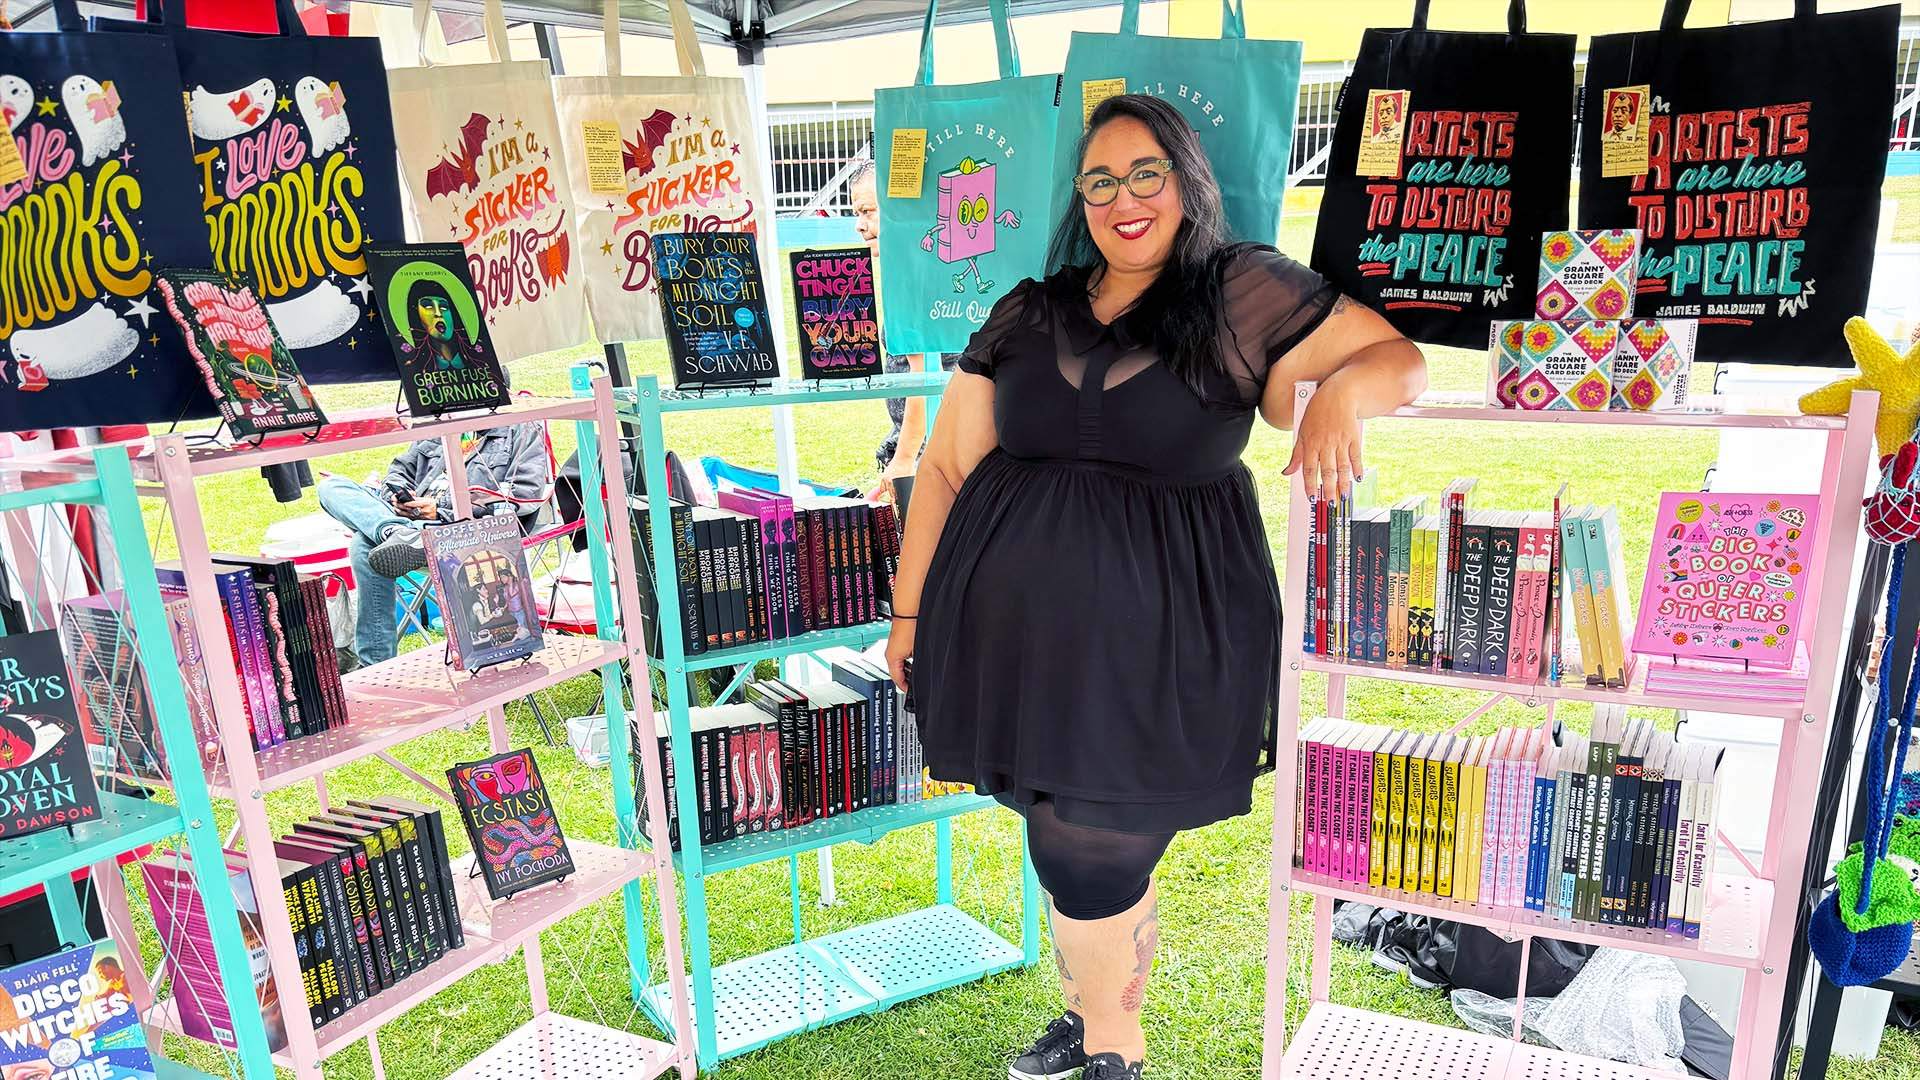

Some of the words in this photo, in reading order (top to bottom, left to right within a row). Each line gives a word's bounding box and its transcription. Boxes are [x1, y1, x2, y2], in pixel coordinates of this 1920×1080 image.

[1178, 84, 1224, 127] HERE
[976, 123, 1014, 158] HERE
[1398, 111, 1520, 165] RTISTS
[194, 147, 224, 212] I
[1407, 159, 1456, 184] are
[1454, 154, 1511, 186] here
[1676, 164, 1730, 192] are
[1732, 154, 1806, 189] here
[458, 166, 556, 248] SUCKER
[614, 160, 742, 234] SUCKER
[1366, 184, 1398, 230] TO
[1401, 186, 1512, 235] DISTURB
[650, 214, 681, 232] FOR
[1628, 196, 1666, 242] TO
[1675, 188, 1810, 240] DISTURB
[482, 230, 508, 254] FOR
[664, 238, 705, 256] BURY
[713, 238, 750, 254] OUR
[667, 258, 743, 280] BONES
[796, 258, 870, 278] CHUCK
[1359, 234, 1401, 262] the
[1393, 233, 1508, 287] PEACE
[1671, 240, 1806, 296] PEACE
[798, 276, 872, 297] TINGLE
[1564, 272, 1604, 280] SQUARE
[184, 281, 226, 306] COSMIC
[221, 286, 257, 310] LOVE
[672, 282, 758, 302] MIDNIGHT
[1380, 289, 1417, 299] JAMES
[1423, 290, 1472, 302] BALDWIN
[676, 305, 734, 327] SOIL
[802, 298, 872, 322] BURY
[930, 300, 962, 320] Still
[1656, 304, 1700, 316] JAMES
[1707, 304, 1766, 316] BALDWIN
[205, 321, 242, 351] HAIR
[238, 323, 275, 350] SALON
[802, 320, 878, 345] YOUR
[685, 353, 772, 374] SCHWAB
[810, 344, 877, 368] GAYS
[414, 371, 458, 388] GREEN
[461, 367, 491, 383] FUSE
[417, 380, 500, 406] BURNING
[252, 416, 286, 428] ANNIE
[288, 412, 318, 424] MARE
[434, 516, 514, 538] COFFEESHOP
[480, 530, 518, 544] Universe
[1724, 526, 1748, 537] THE
[1466, 553, 1483, 562] THE
[1708, 536, 1758, 554] BIG
[727, 547, 735, 580] MIRROR
[732, 547, 740, 579] BROKEN
[796, 533, 809, 587] CEMETERY
[1493, 555, 1510, 564] THE
[1690, 552, 1773, 575] BOOK
[770, 579, 775, 588] WE
[1388, 576, 1397, 606] Monster
[1463, 563, 1482, 604] DEEP
[1490, 566, 1510, 607] DEEP
[1677, 580, 1765, 602] QUEER
[1717, 574, 1735, 583] OF
[801, 589, 811, 617] BOYS
[1658, 598, 1786, 622] STICKERS
[179, 610, 197, 665] COFFEESHOP
[1457, 605, 1479, 650] DARK
[1484, 608, 1506, 654] DARK
[796, 705, 808, 727] HEADS
[798, 729, 809, 745] WILL
[799, 747, 809, 763] ROLL
[1591, 746, 1599, 762] LAPP
[1605, 748, 1613, 763] LAPP
[1374, 758, 1388, 793] SLAYERS
[1443, 766, 1457, 802] SLAYERS
[470, 790, 547, 828] ECSTASY
[1585, 774, 1597, 823] CROCHET
[1598, 776, 1612, 824] CROCHET
[16, 806, 93, 830] DAWSON
[1695, 823, 1709, 841] Tarot
[1579, 824, 1592, 879] MONSTERS
[1591, 826, 1606, 881] MONSTERS
[1695, 841, 1706, 852] for
[496, 871, 512, 884] IVY
[516, 854, 568, 878] POCHODA
[1690, 853, 1706, 888] Creativity
[300, 881, 319, 925] HYACINTH
[307, 878, 319, 899] VOICE
[314, 900, 323, 914] LIKE
[343, 876, 362, 918] ECSTASY
[397, 866, 409, 888] LAMB
[404, 904, 415, 924] LUCY
[410, 925, 420, 944] ROSE
[14, 970, 50, 990] BLAIR
[52, 963, 78, 978] FELL
[317, 963, 333, 999] PEARSON
[325, 959, 340, 996] MALLORY
[13, 973, 98, 1018] DISCO
[0, 993, 129, 1053] WITCHES
